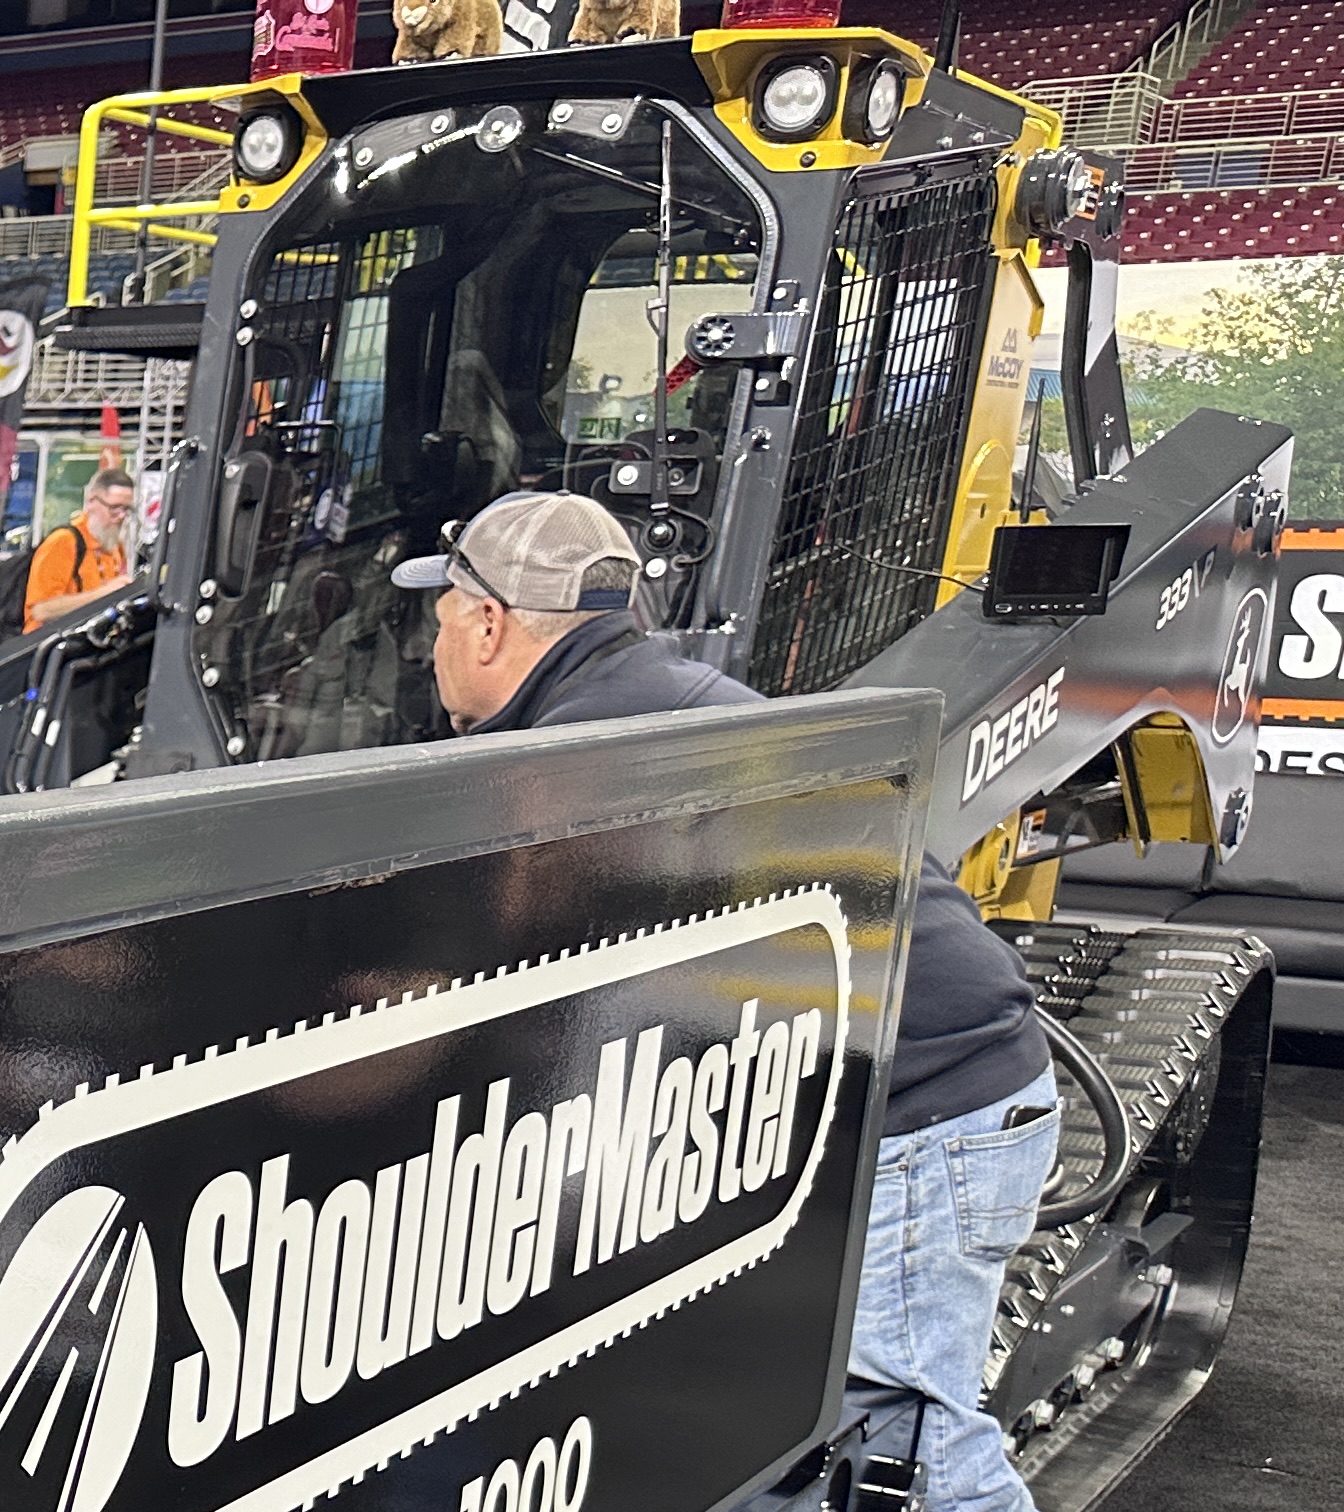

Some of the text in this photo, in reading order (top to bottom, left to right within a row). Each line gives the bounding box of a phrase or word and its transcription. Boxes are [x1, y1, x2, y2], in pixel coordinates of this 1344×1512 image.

[1155, 567, 1193, 630] 333
[961, 665, 1066, 802] DEERE
[167, 997, 822, 1468] ShoulderMaster
